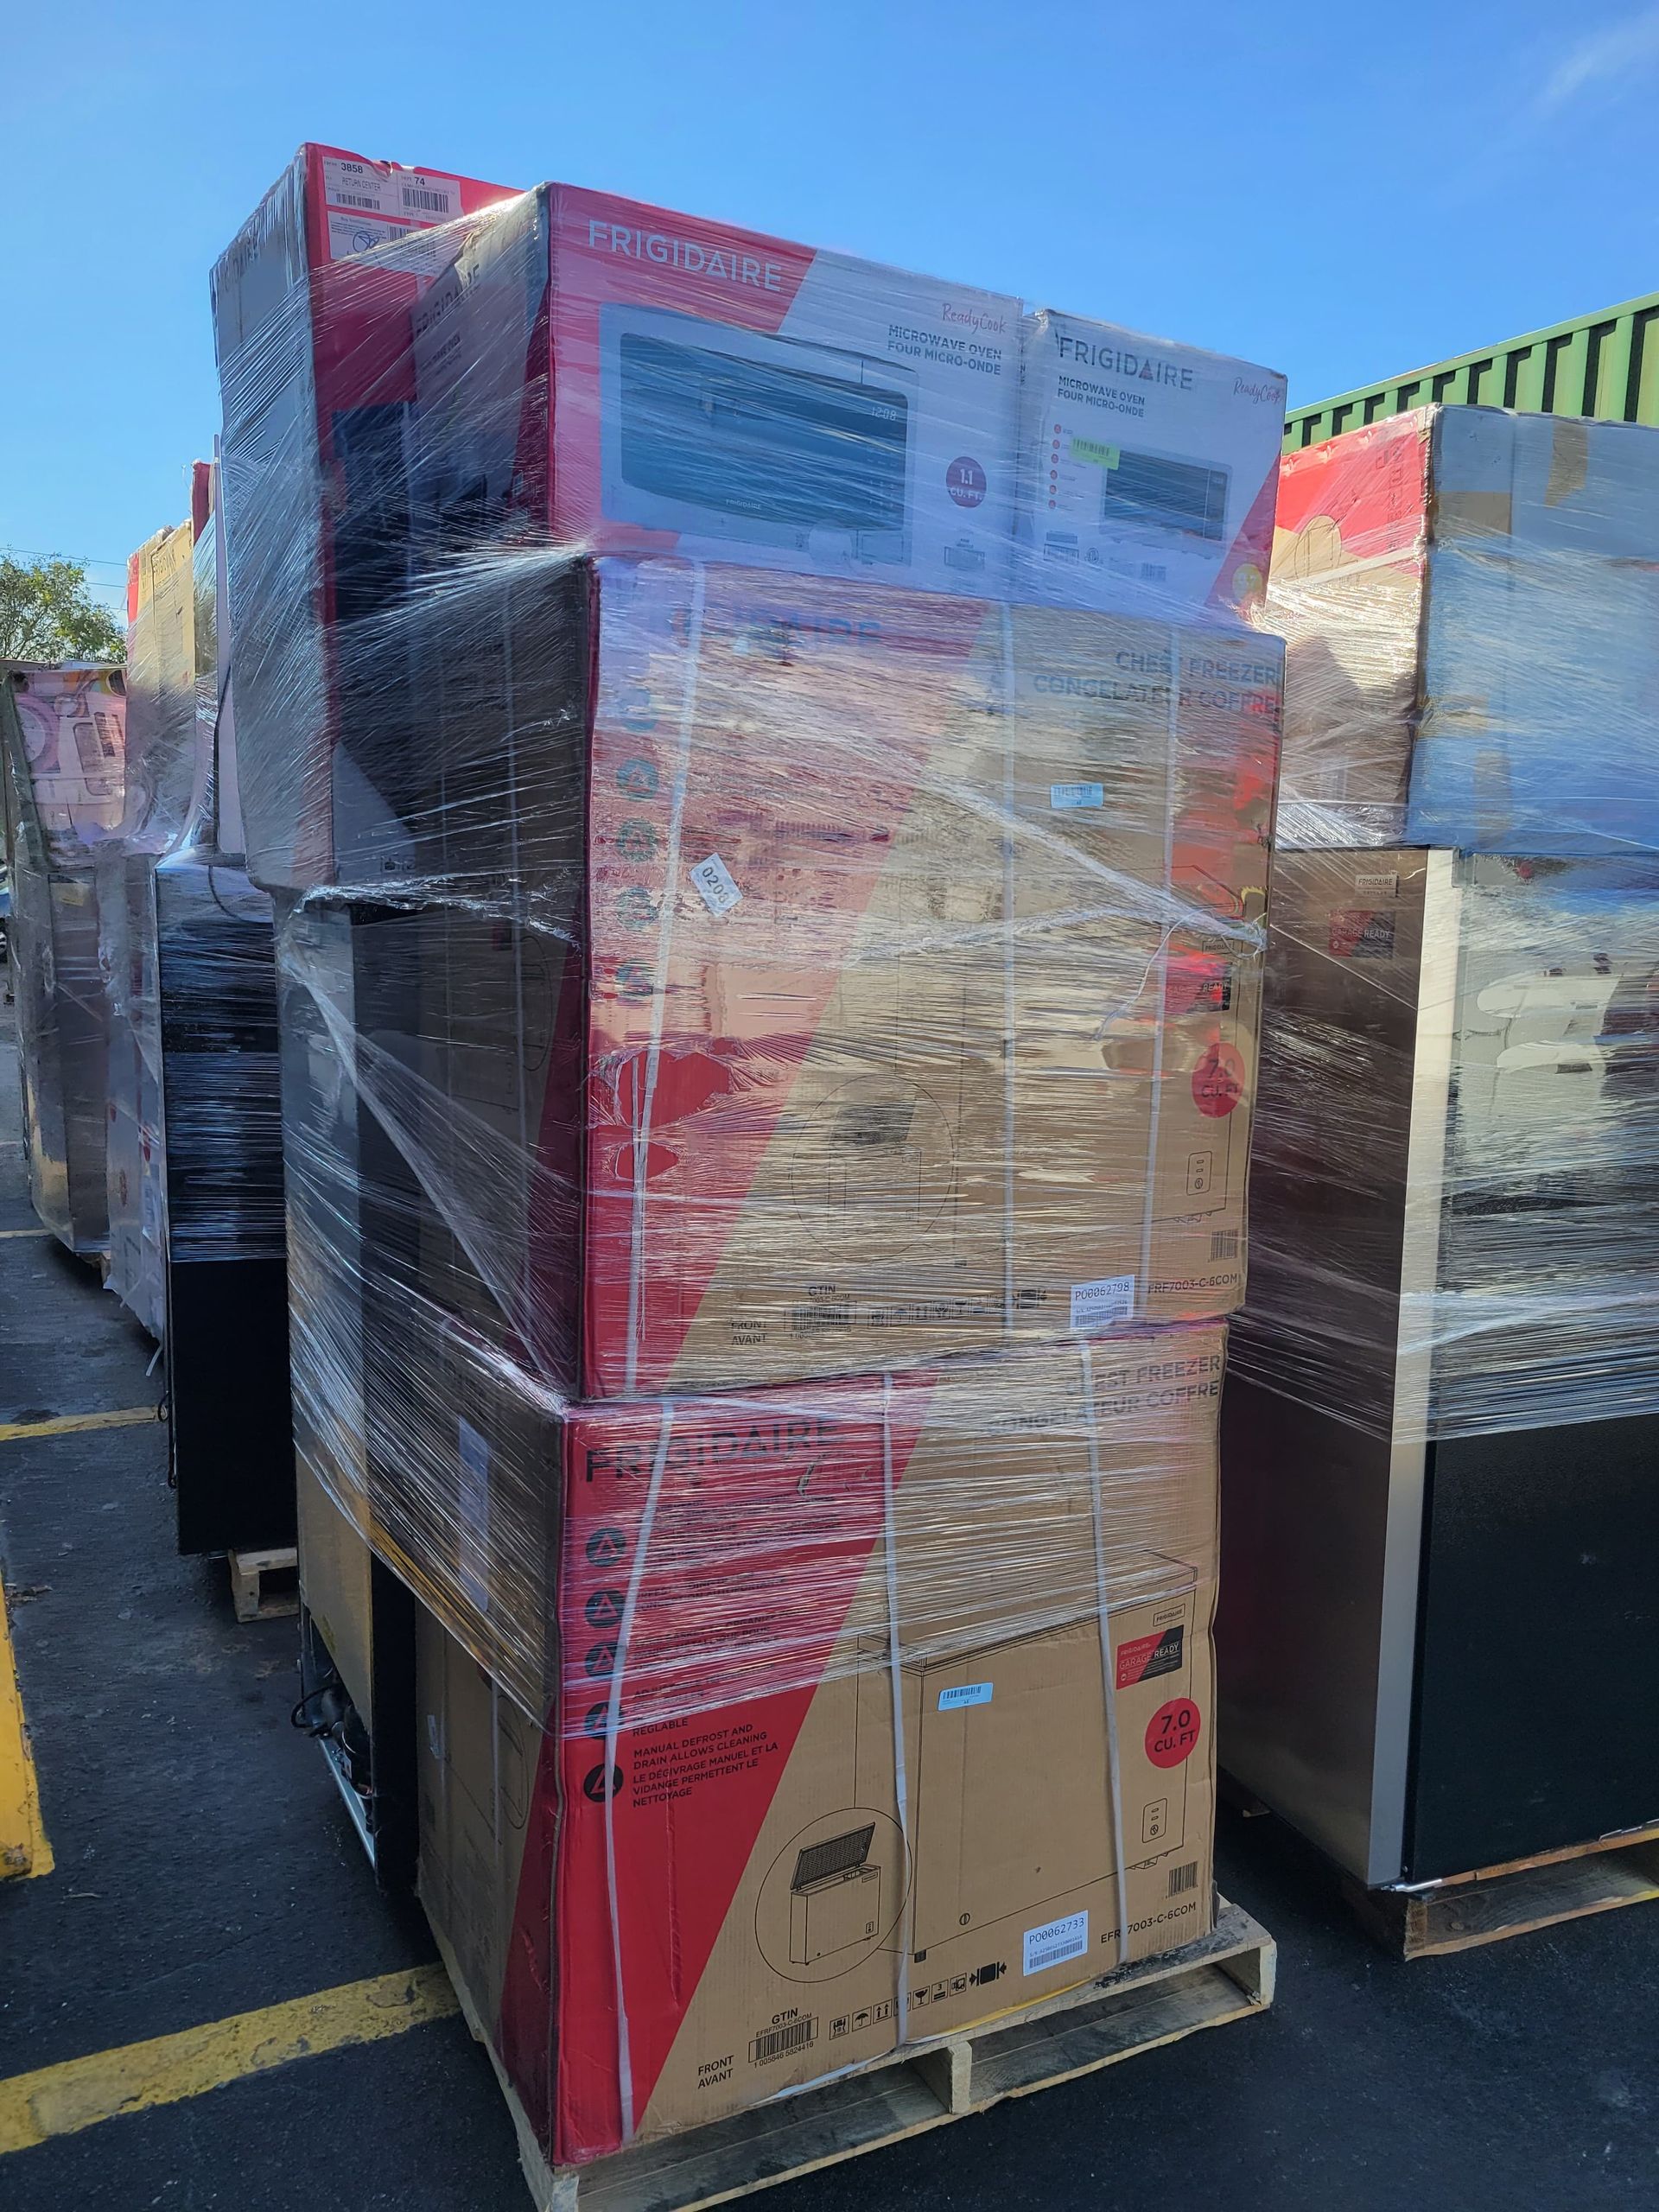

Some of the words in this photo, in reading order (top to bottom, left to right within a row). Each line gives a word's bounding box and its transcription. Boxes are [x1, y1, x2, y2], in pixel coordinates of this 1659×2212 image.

[340, 162, 363, 174] 3858
[415, 176, 425, 186] 74
[342, 176, 361, 188] RETURN
[362, 180, 380, 191] CENTER
[588, 219, 782, 292] FRIGIDAIRE
[942, 302, 1008, 334] ReadyCook
[888, 324, 966, 352] MICROWAVE
[969, 345, 1002, 360] OVEN
[887, 340, 921, 357] FOUR
[925, 348, 1001, 375] MICRO-ONDE
[1059, 337, 1193, 390] FRIGIDAIRE
[1058, 376, 1118, 399] MICROWAVE
[1121, 392, 1146, 405] OVEN
[1058, 388, 1084, 403] FOUR
[1085, 395, 1144, 417] MICRO-ONDE
[960, 469, 973, 485] 1.1
[950, 486, 966, 499] CU.
[1363, 928, 1390, 938] READY
[731, 1333, 767, 1345] AVANT
[1136, 1355, 1221, 1382] FREEZER
[1146, 1381, 1218, 1406] COFFRE
[1120, 1652, 1153, 1669] GARAGE
[1154, 1642, 1179, 1658] READY
[1161, 1709, 1191, 1735] 7.0
[633, 1742, 679, 1759] MANUAL
[682, 1730, 730, 1748] DEFROST
[732, 1724, 753, 1736] AND
[633, 1754, 667, 1770] DRAIN
[670, 1745, 715, 1763] ALLOWS
[716, 1731, 768, 1751] CLEANING
[1154, 1737, 1176, 1752] CU.
[1180, 1730, 1196, 1745] FT
[632, 1775, 645, 1784] LE
[649, 1759, 707, 1781] DÉGIVRAGE
[709, 1750, 749, 1767] MANUEL
[751, 1745, 763, 1757] ET
[766, 1742, 779, 1752] LA
[632, 1778, 679, 1796] VIDANGE
[681, 1763, 744, 1785] PERMETTENT
[747, 1758, 759, 1769] LE
[632, 1787, 693, 1808] NETTOYAGE
[1100, 1901, 1197, 1944] EFR7003-C-6COM
[772, 2007, 798, 2024] GTIN
[697, 2055, 734, 2076] FRONT
[697, 2069, 734, 2089] AVANT
